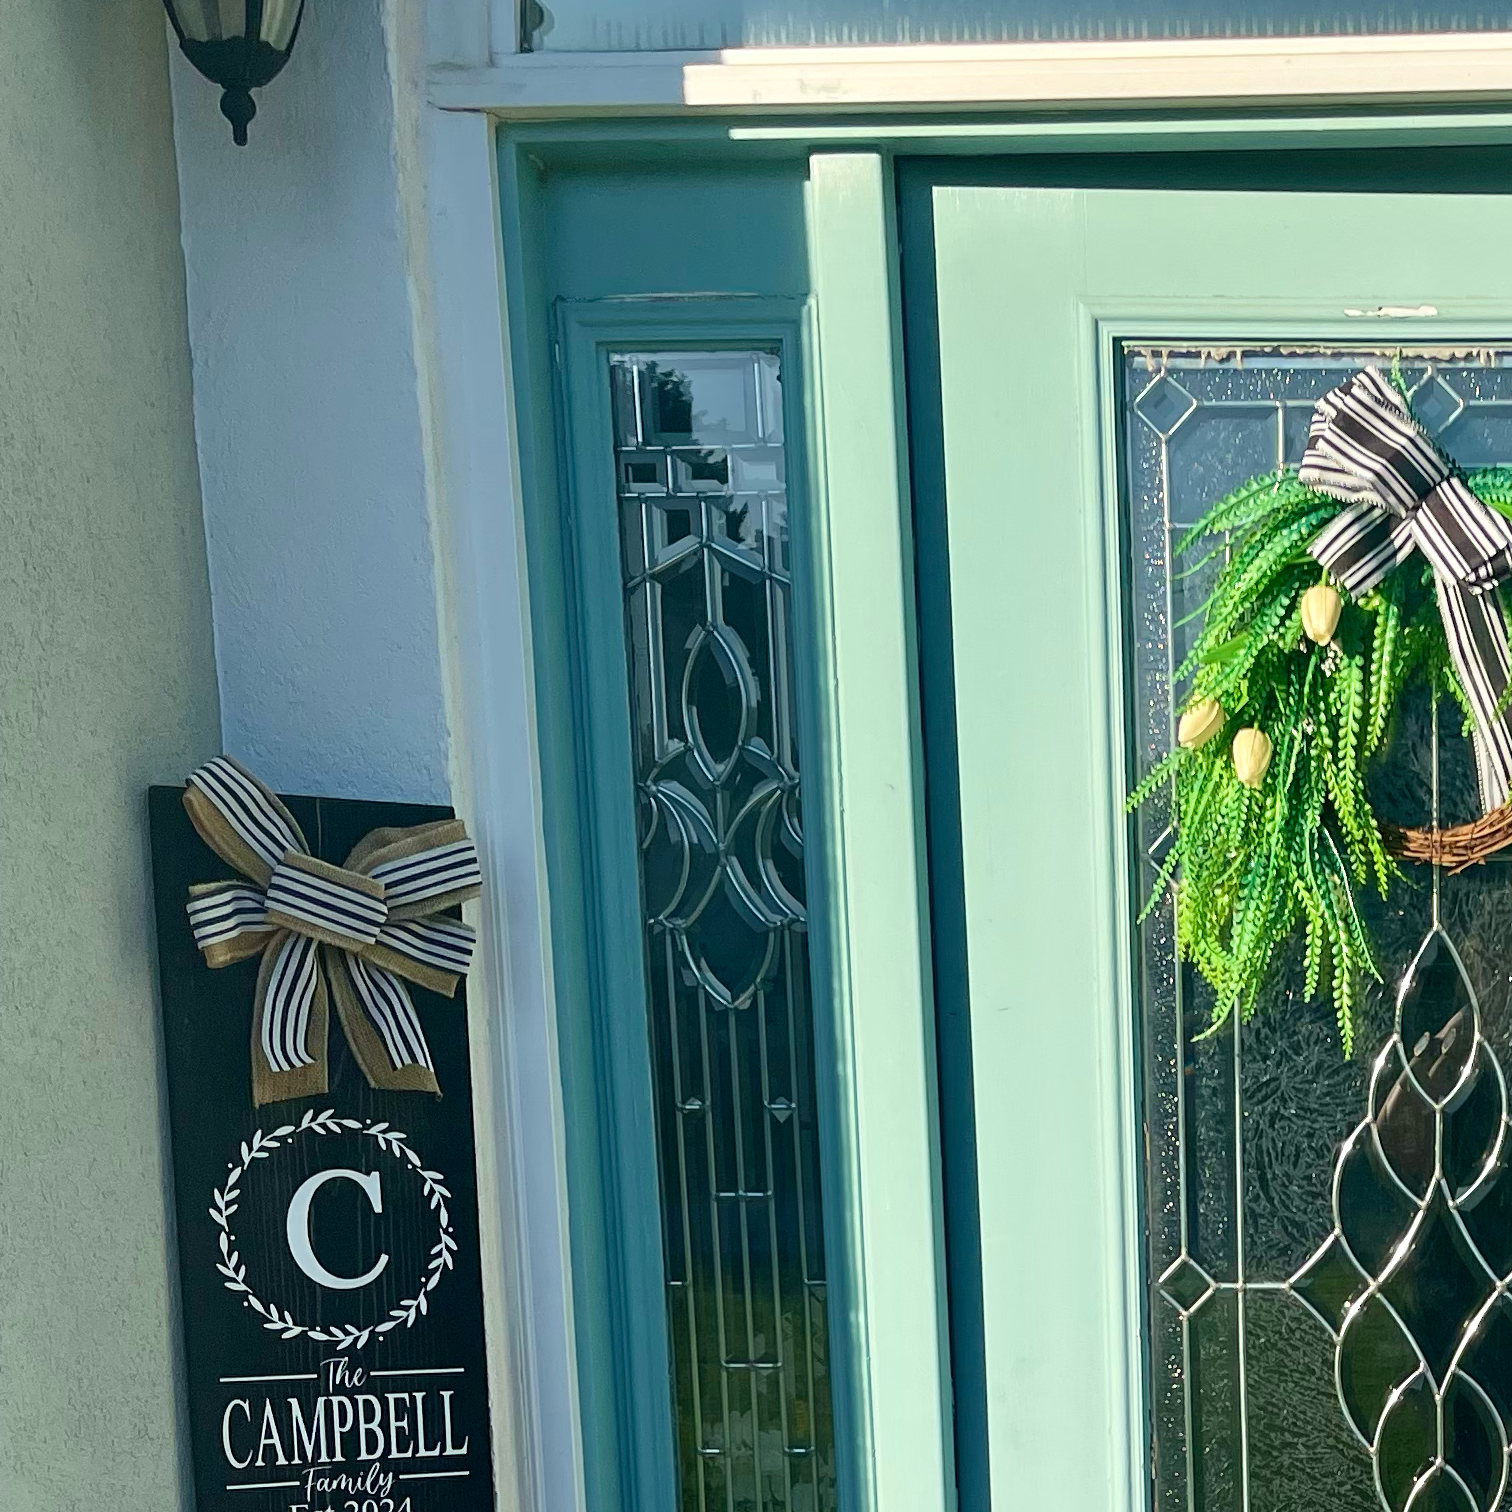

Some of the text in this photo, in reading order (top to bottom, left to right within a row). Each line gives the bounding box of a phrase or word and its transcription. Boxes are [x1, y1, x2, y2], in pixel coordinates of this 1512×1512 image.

[286, 1168, 389, 1290] C
[319, 1356, 367, 1395] The
[222, 1390, 469, 1469] CAMPBELL
[301, 1461, 396, 1503] Family
